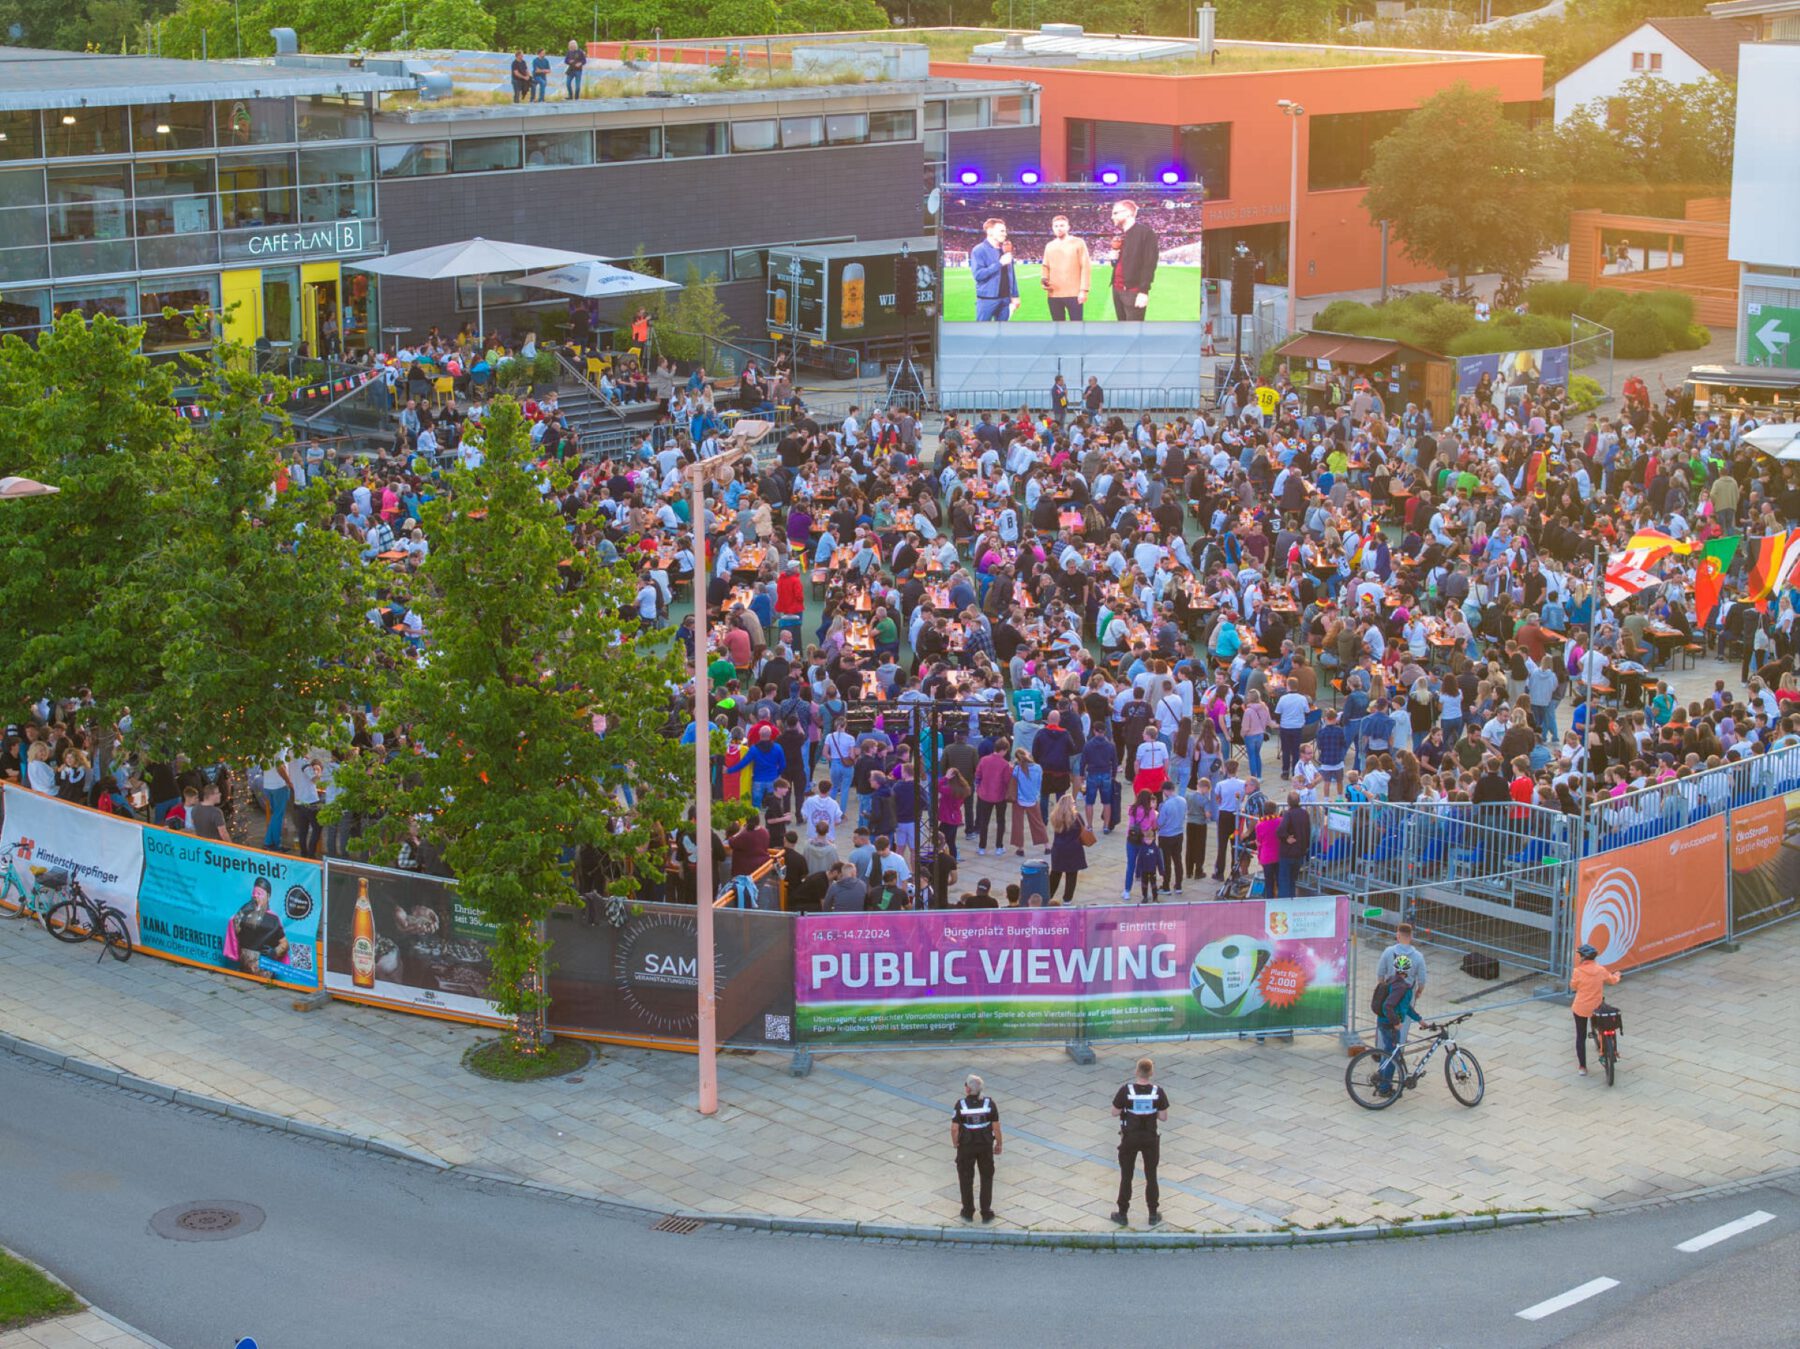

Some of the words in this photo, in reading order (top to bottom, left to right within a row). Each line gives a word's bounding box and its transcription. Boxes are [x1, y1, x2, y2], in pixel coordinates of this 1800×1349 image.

[248, 232, 289, 254] CAFÉ
[294, 230, 332, 250] PLAN
[344, 226, 354, 248] B
[36, 847, 119, 884] Hinterschwepfinger
[147, 836, 175, 857] Bock
[180, 846, 202, 862] auf
[204, 849, 288, 880] Superheld?
[143, 915, 171, 937] KANAL
[172, 924, 224, 951] OBERREITER
[943, 925, 1004, 939] Bürgerplatz
[1007, 925, 1070, 938] Burghausen
[1120, 921, 1156, 932] Eintritt
[1160, 919, 1177, 931] frei
[812, 930, 836, 942] 14.6.
[644, 952, 697, 978] SAM
[811, 950, 967, 990] PUBLIC
[978, 943, 1177, 985] VIEWING
[1270, 969, 1287, 977] Platz
[1269, 976, 1297, 988] 2.000
[962, 1011, 977, 1019] und
[1088, 1008, 1101, 1017] auf
[1125, 1006, 1139, 1014] LED
